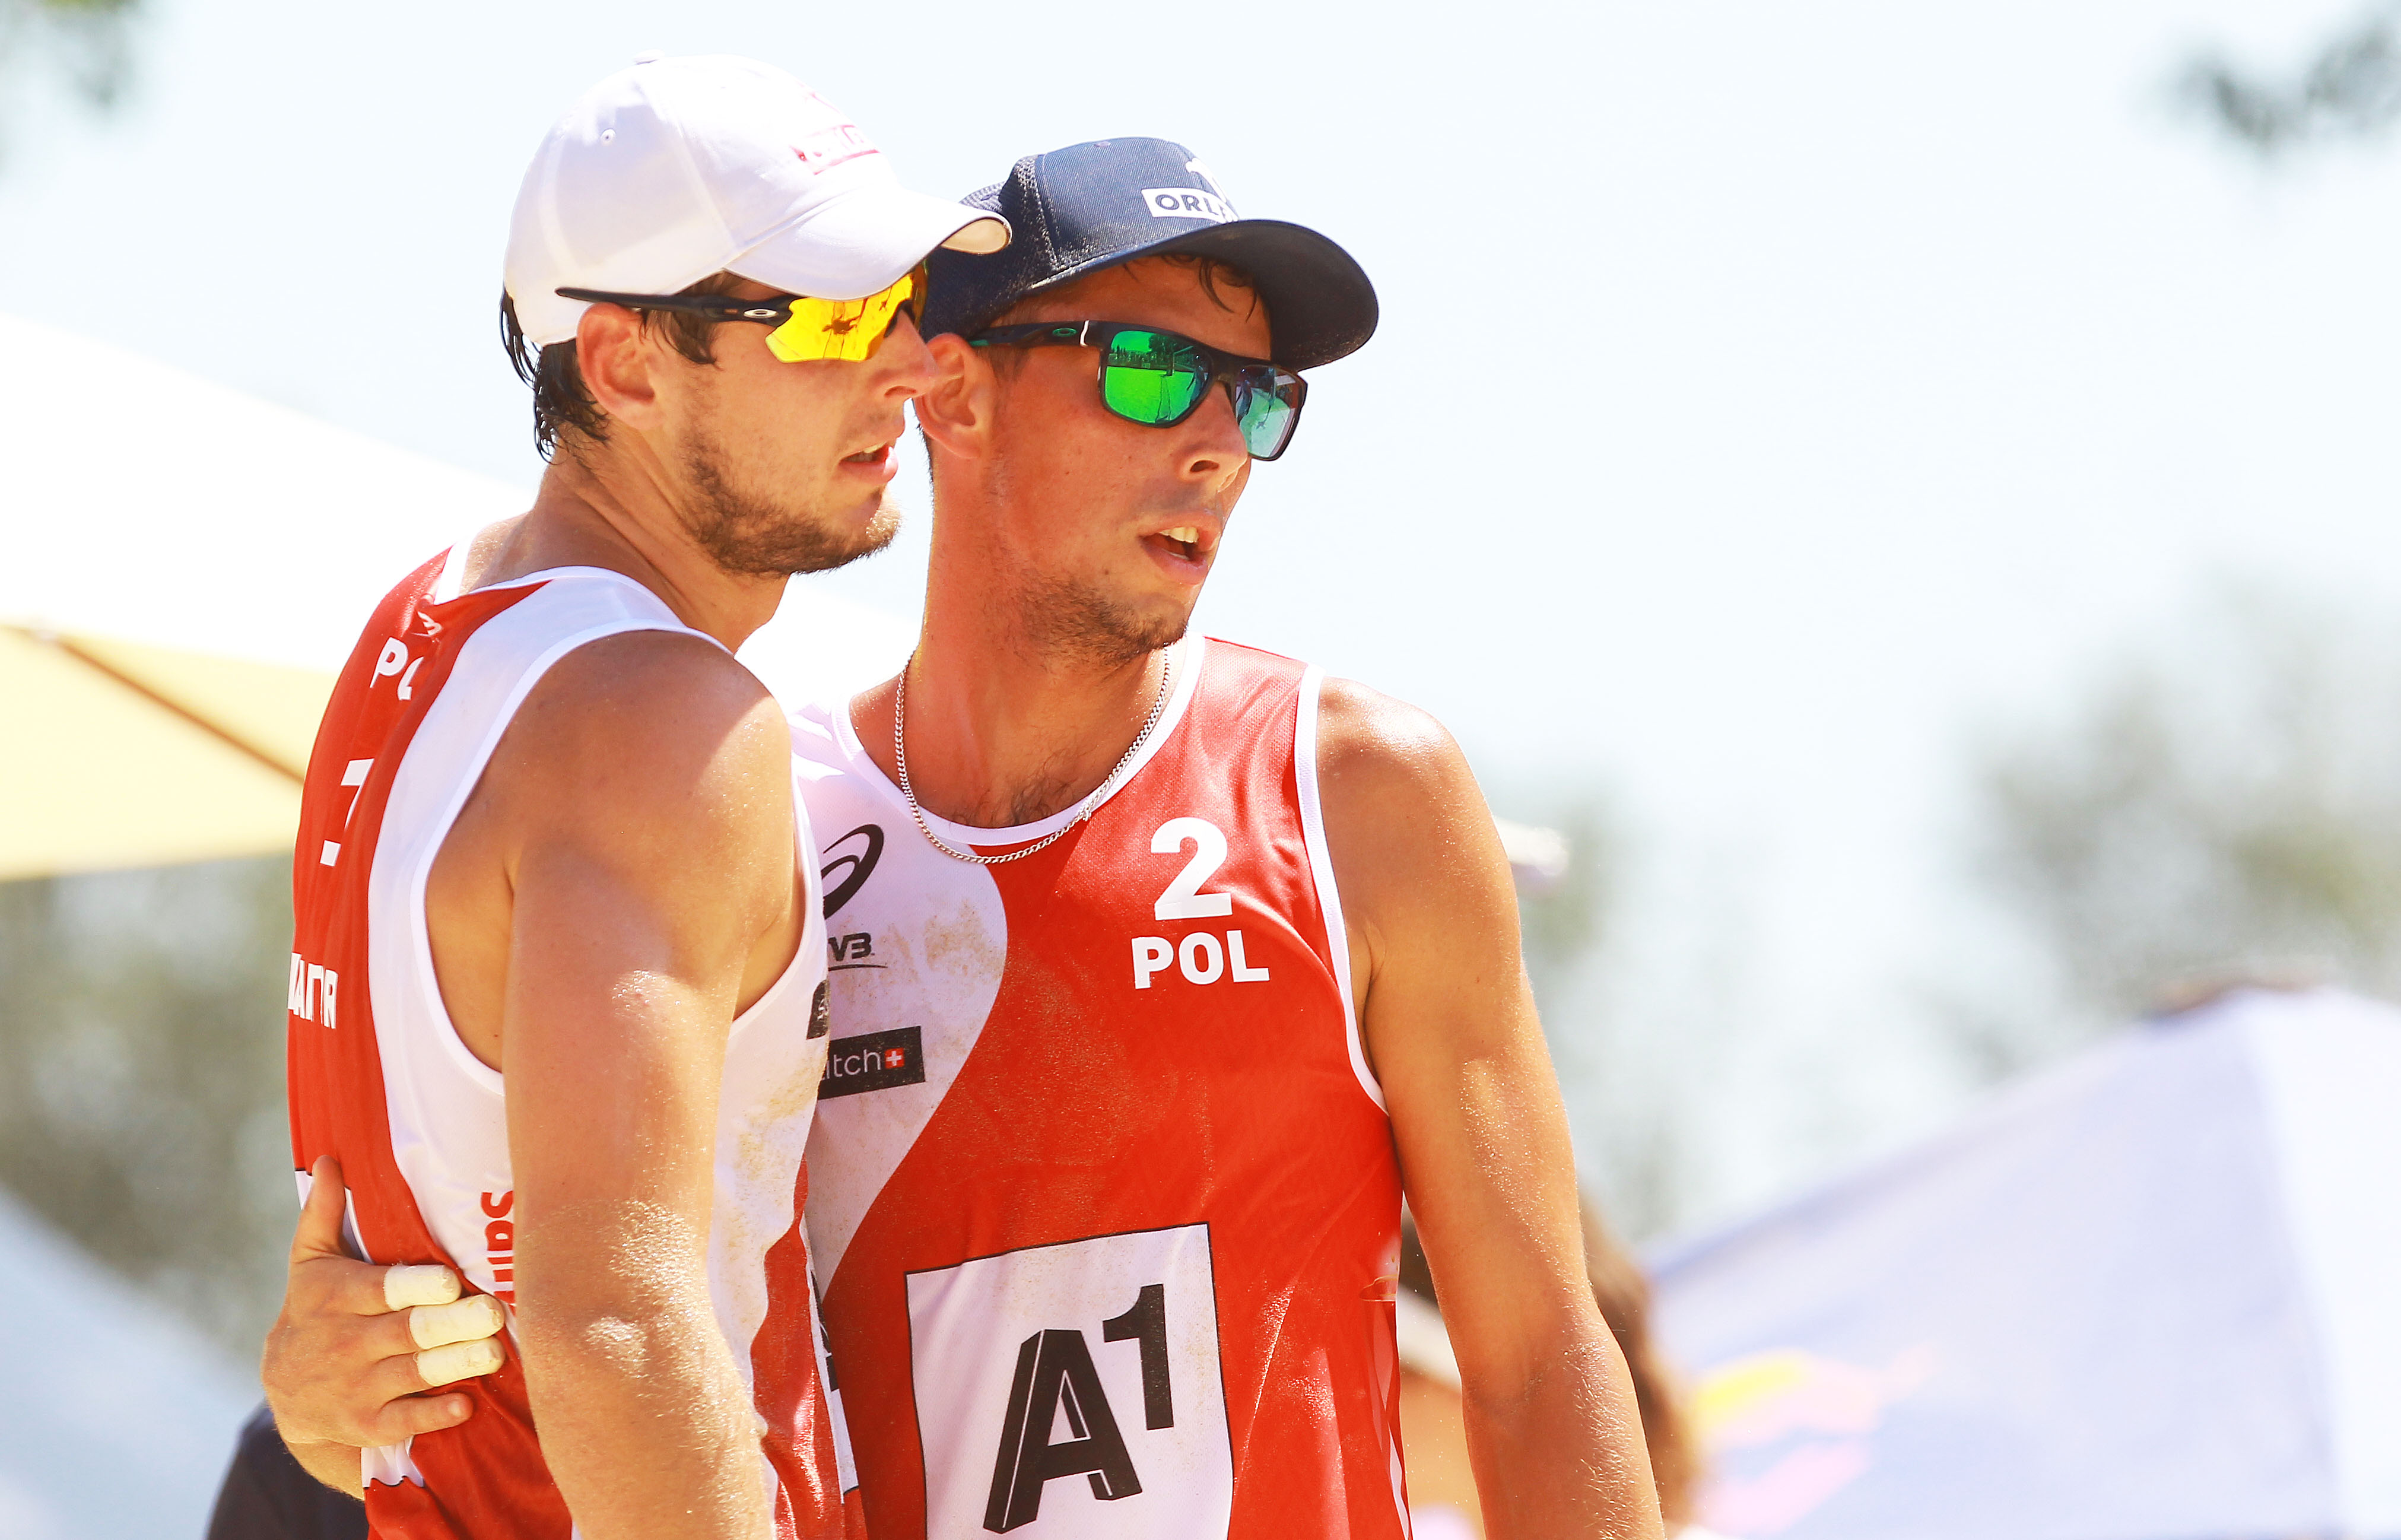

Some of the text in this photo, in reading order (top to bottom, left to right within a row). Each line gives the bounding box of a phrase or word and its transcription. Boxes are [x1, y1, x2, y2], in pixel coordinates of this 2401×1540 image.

[1150, 817, 1233, 921] 2
[1131, 929, 1271, 989] POL
[983, 1283, 1174, 1535] A1
